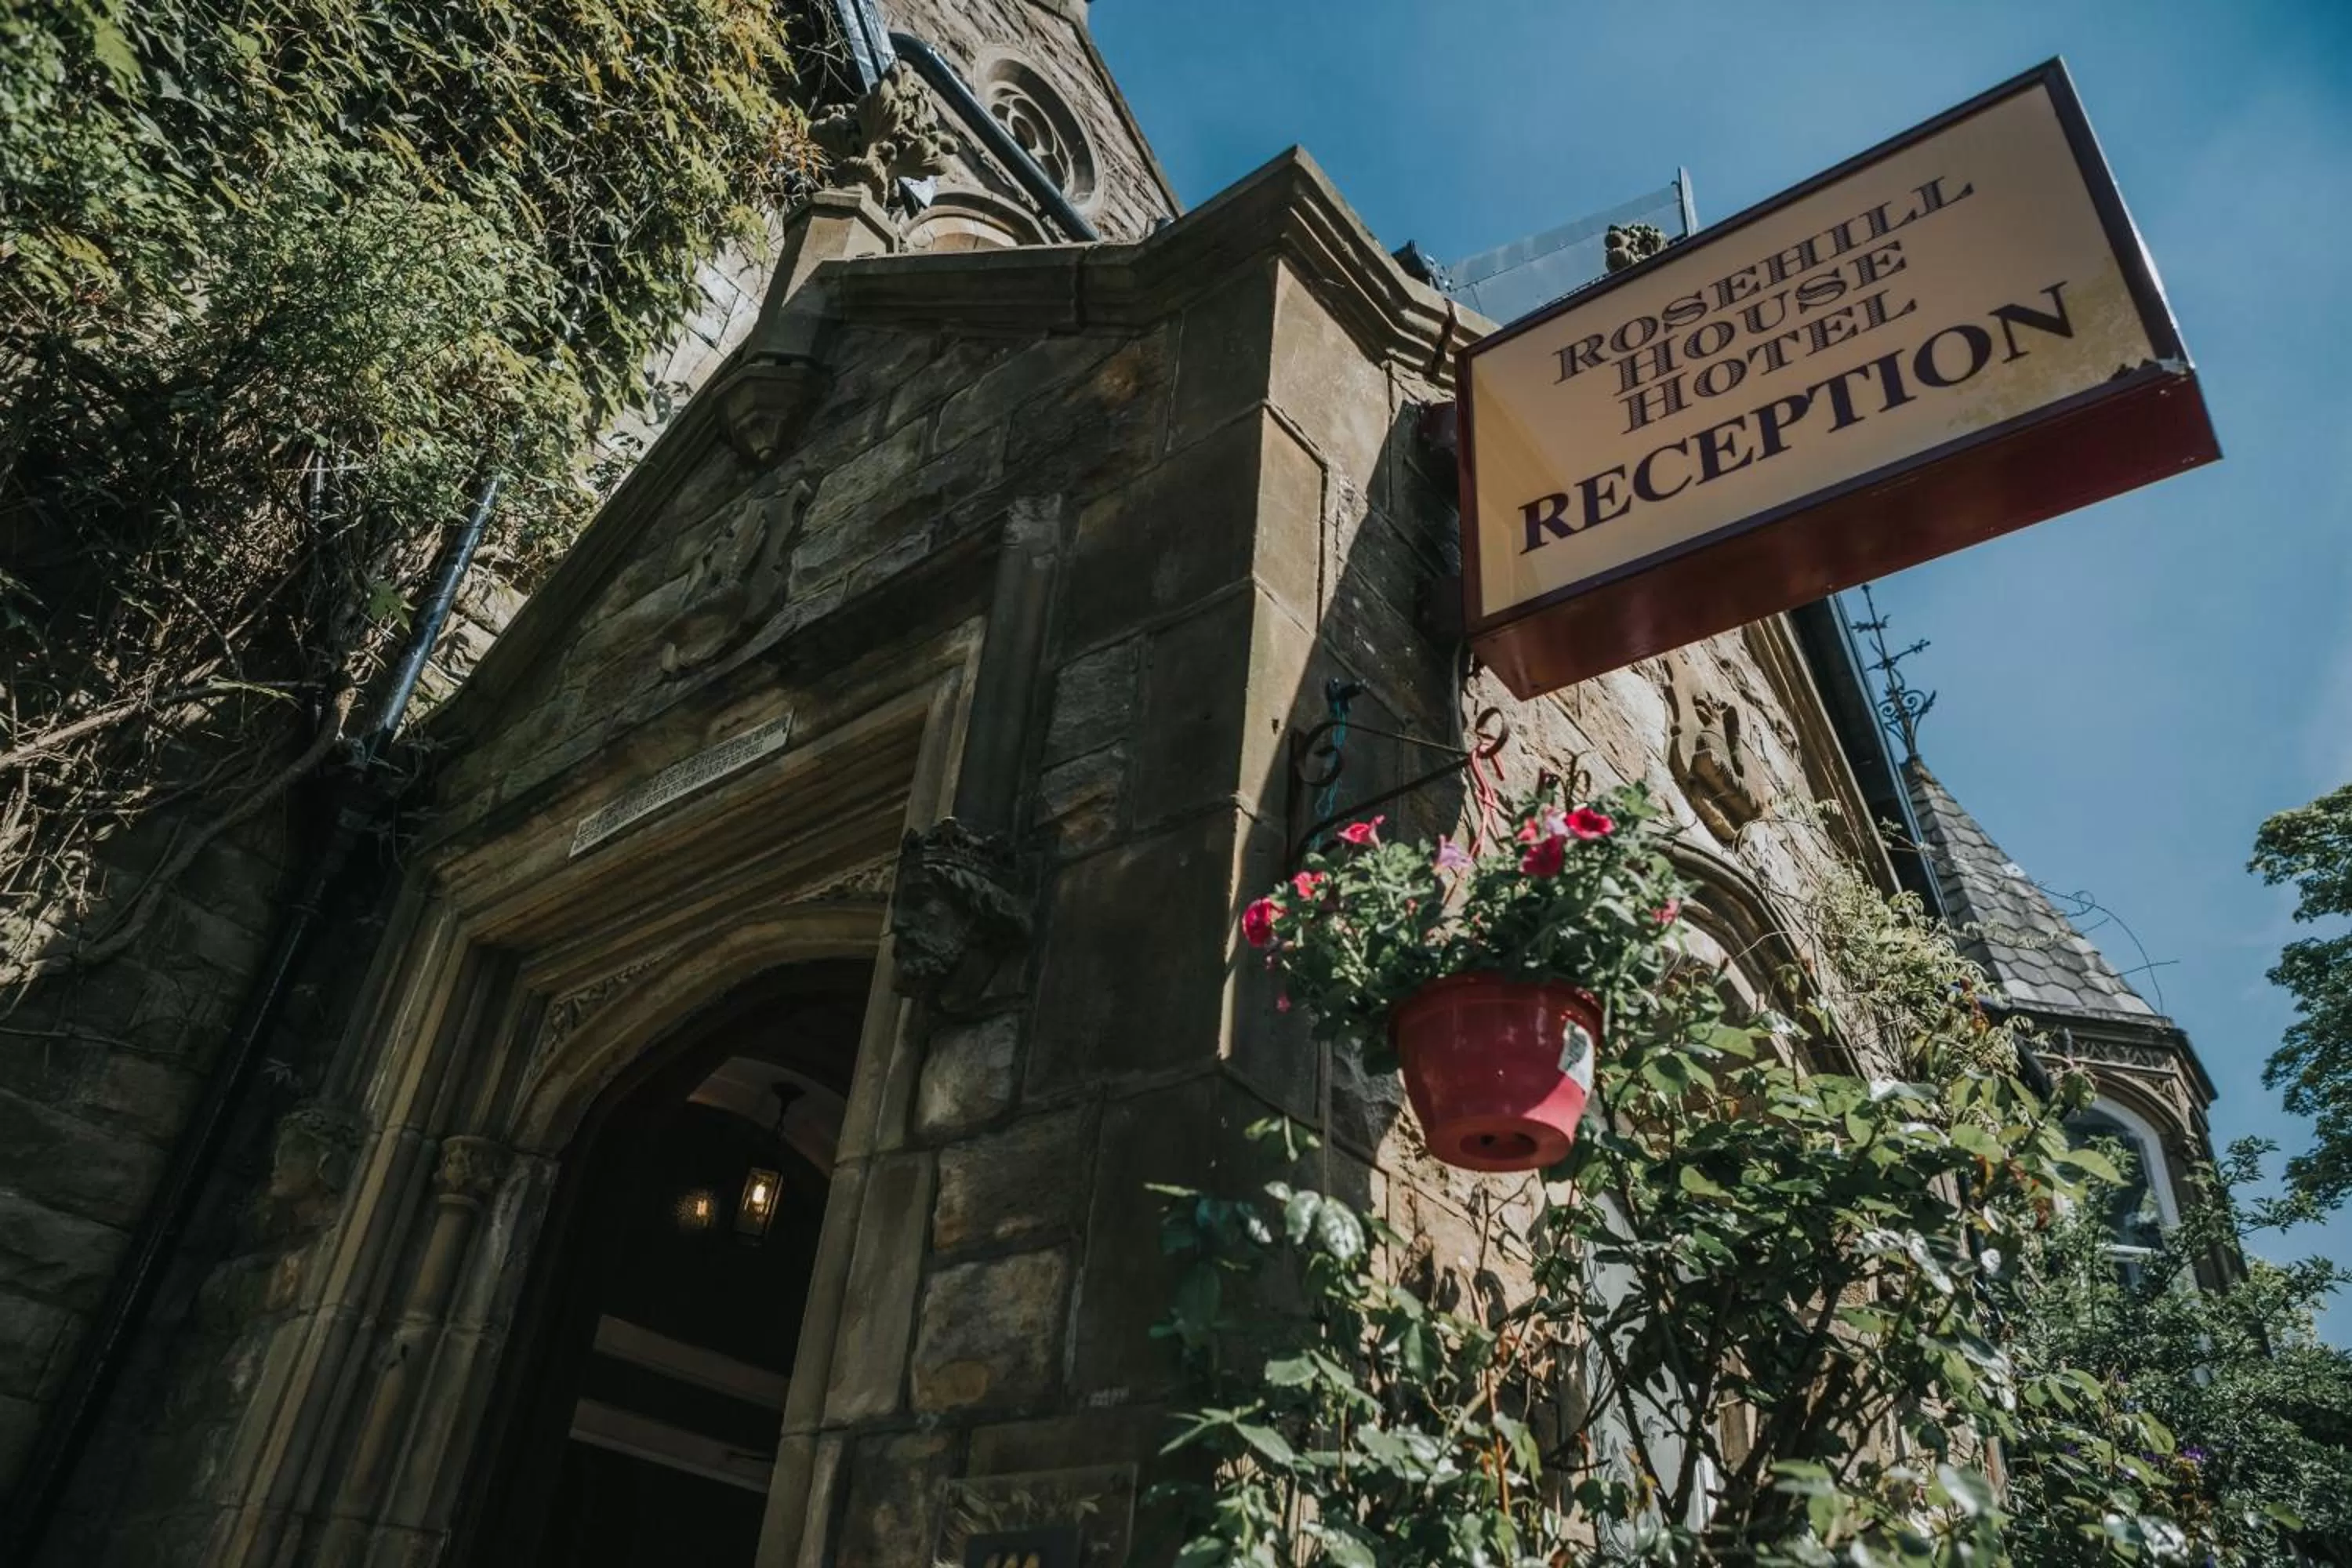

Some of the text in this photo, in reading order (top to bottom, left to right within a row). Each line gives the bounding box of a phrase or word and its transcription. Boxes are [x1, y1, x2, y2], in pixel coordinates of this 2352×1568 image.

[1552, 176, 1975, 384] ROSEHILL
[1613, 241, 1907, 394] HOUSE
[1621, 290, 1917, 434] HOTEL
[1519, 281, 2075, 555] RECEPTION
